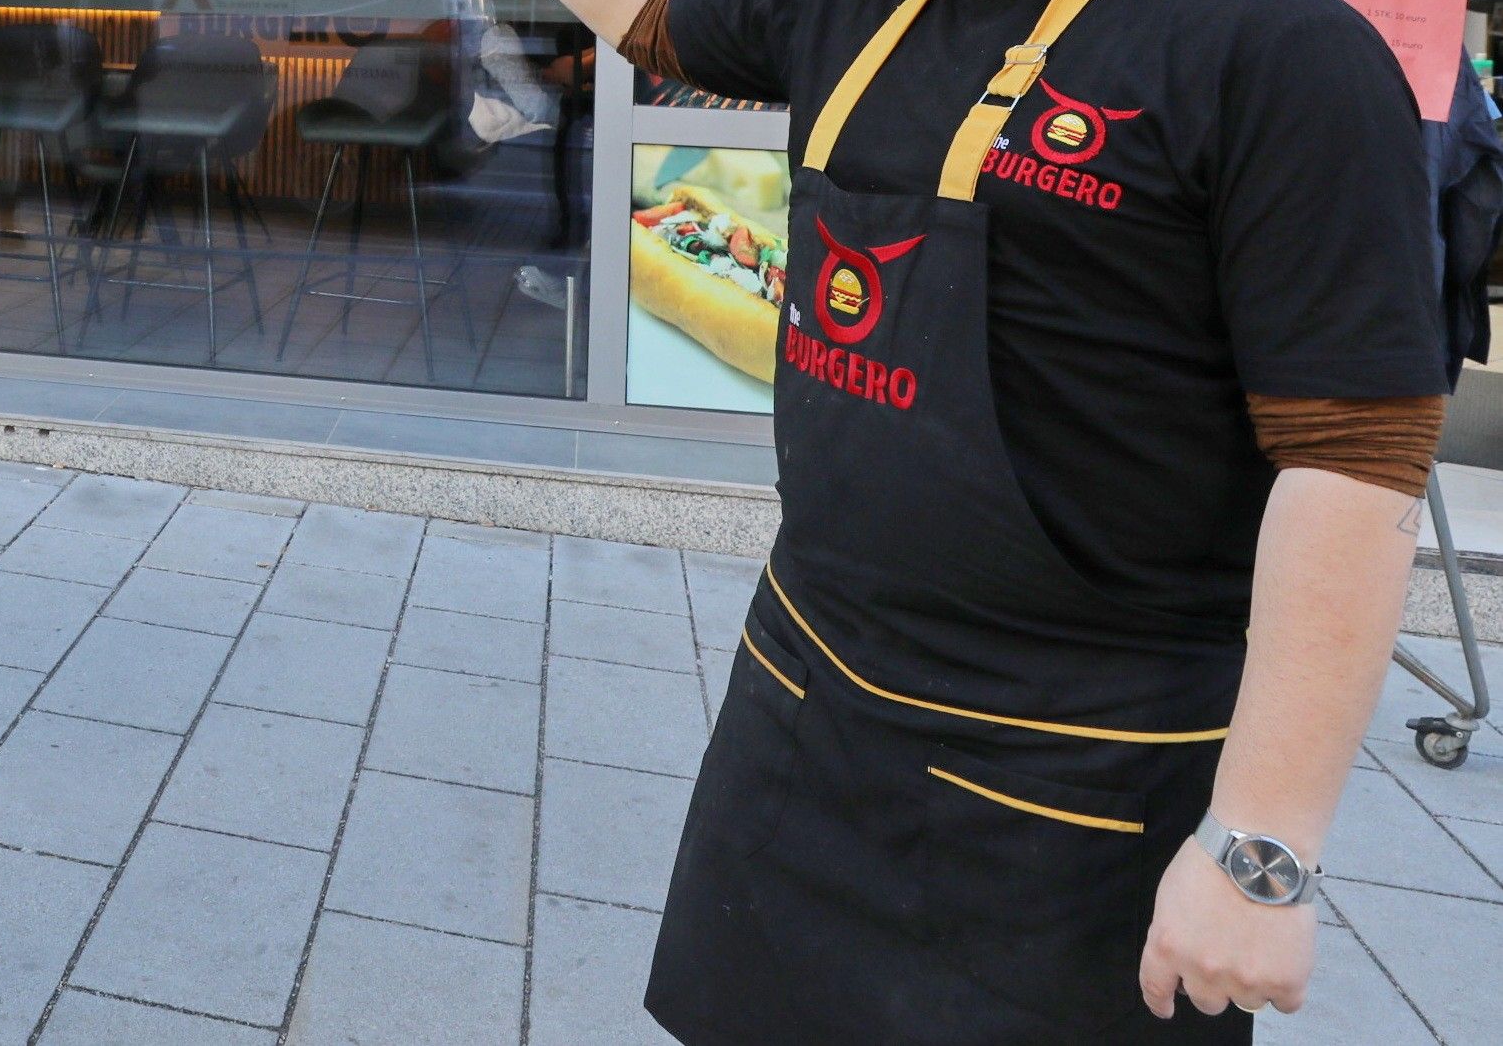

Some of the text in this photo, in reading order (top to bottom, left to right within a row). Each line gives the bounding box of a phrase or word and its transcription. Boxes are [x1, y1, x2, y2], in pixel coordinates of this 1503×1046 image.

[992, 133, 1010, 150] he
[981, 148, 1123, 210] BURGERO
[785, 323, 917, 411] BURGERO
